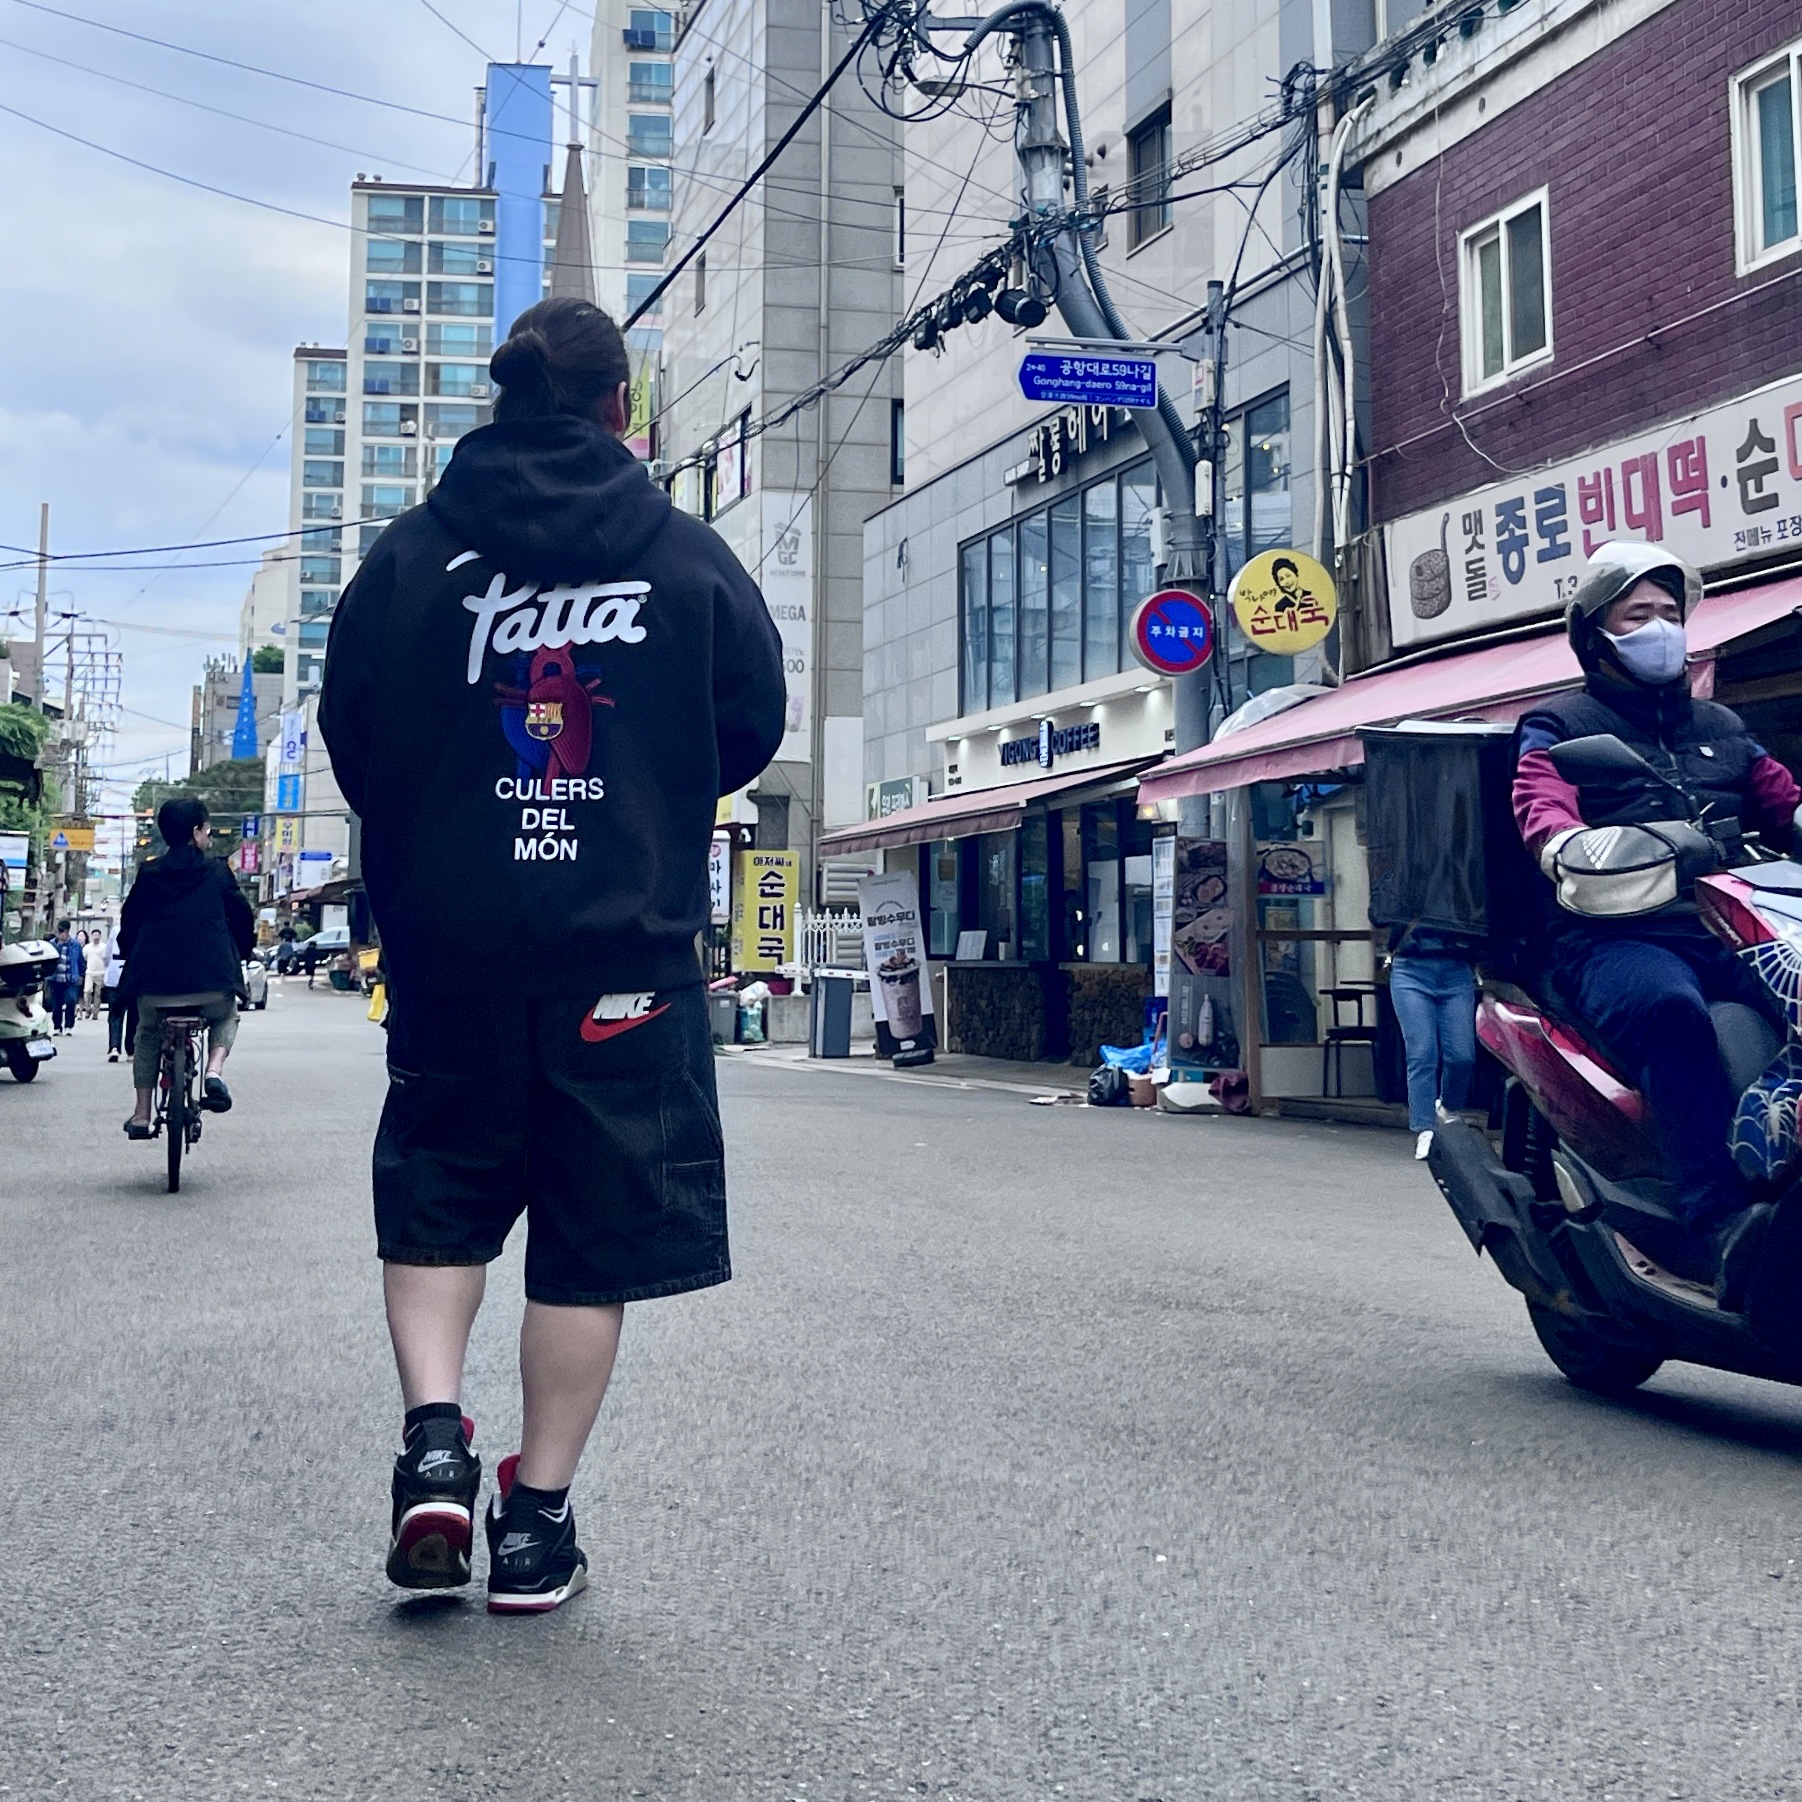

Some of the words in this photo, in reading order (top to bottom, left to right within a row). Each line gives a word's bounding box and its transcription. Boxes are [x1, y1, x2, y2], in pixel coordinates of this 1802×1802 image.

[1060, 360, 1152, 380] 공항대로59나길
[1033, 376, 1112, 390] Gonghang-daero
[1115, 382, 1152, 394] 59na-gil
[1734, 526, 1772, 551] 전뉴
[768, 605, 806, 622] MEGA
[1151, 626, 1204, 639] 주차금지
[1052, 723, 1099, 755] COFFEE
[495, 777, 604, 801] CULERS
[522, 808, 575, 831] DEL
[514, 832, 578, 860] MÓN
[757, 870, 786, 965] 순대국
[592, 991, 656, 1020] NIKE
[423, 1450, 453, 1462] NIKE
[502, 1557, 531, 1566] AIR
